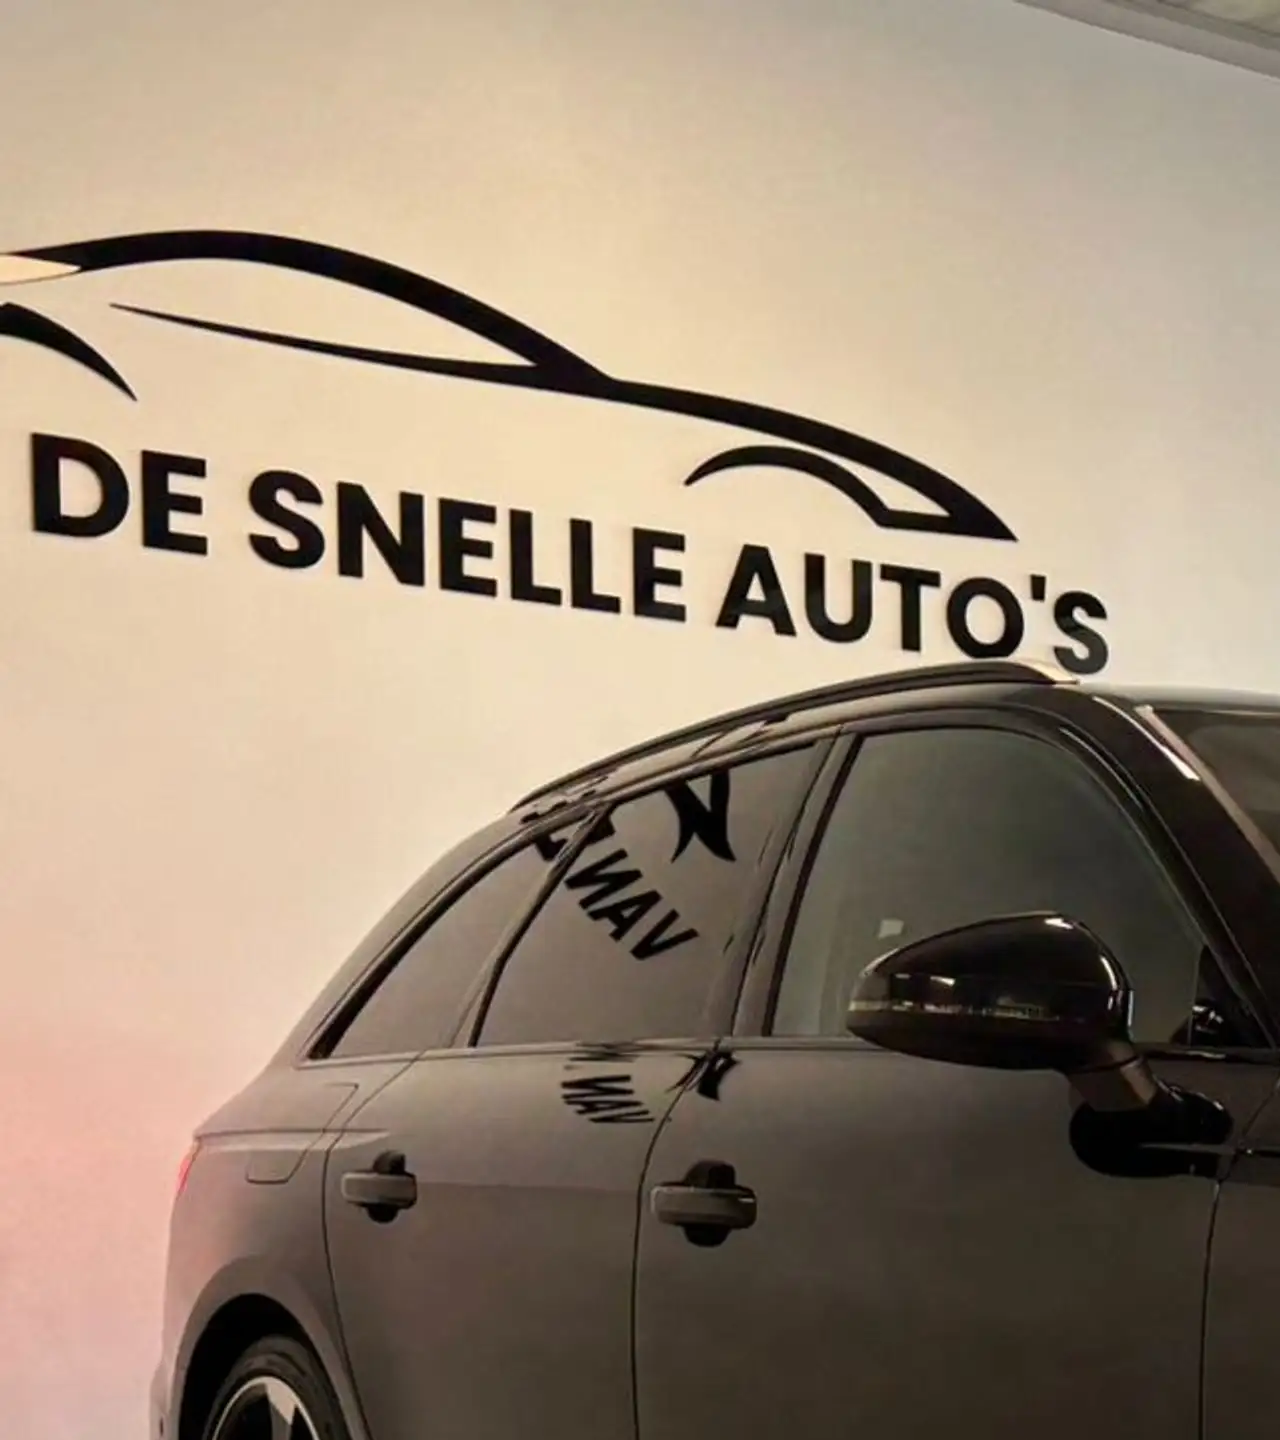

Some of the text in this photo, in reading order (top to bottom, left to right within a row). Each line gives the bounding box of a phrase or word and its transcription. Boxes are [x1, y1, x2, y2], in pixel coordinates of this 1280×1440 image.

[31, 433, 1109, 675] DE SNELLE AUTO'S
